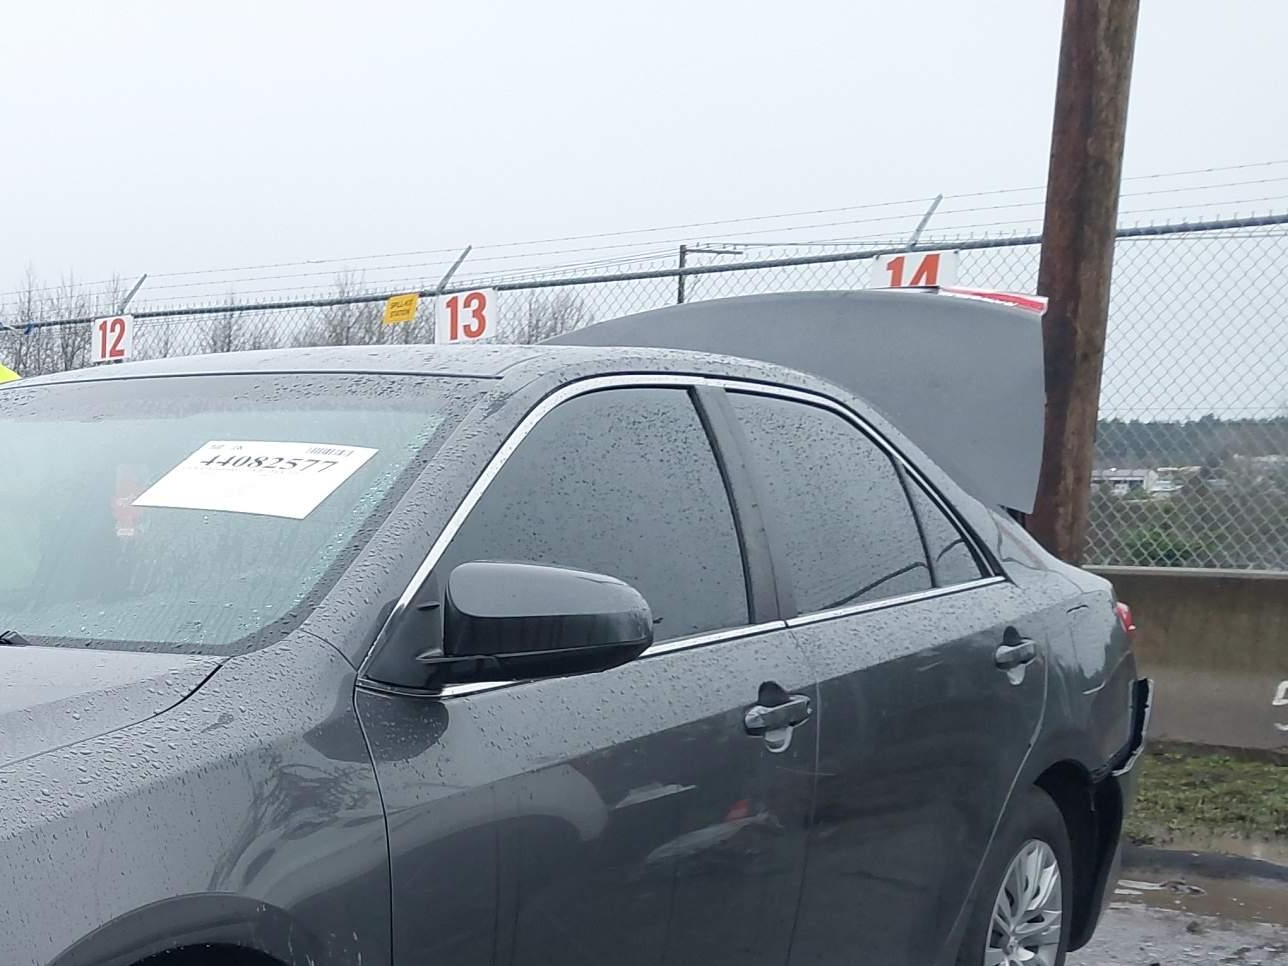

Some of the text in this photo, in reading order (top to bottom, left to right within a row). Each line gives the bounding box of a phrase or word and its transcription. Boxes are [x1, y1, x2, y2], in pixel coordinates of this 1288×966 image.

[446, 292, 487, 340] 13
[99, 318, 125, 359] 12
[200, 455, 339, 472] 44082577
